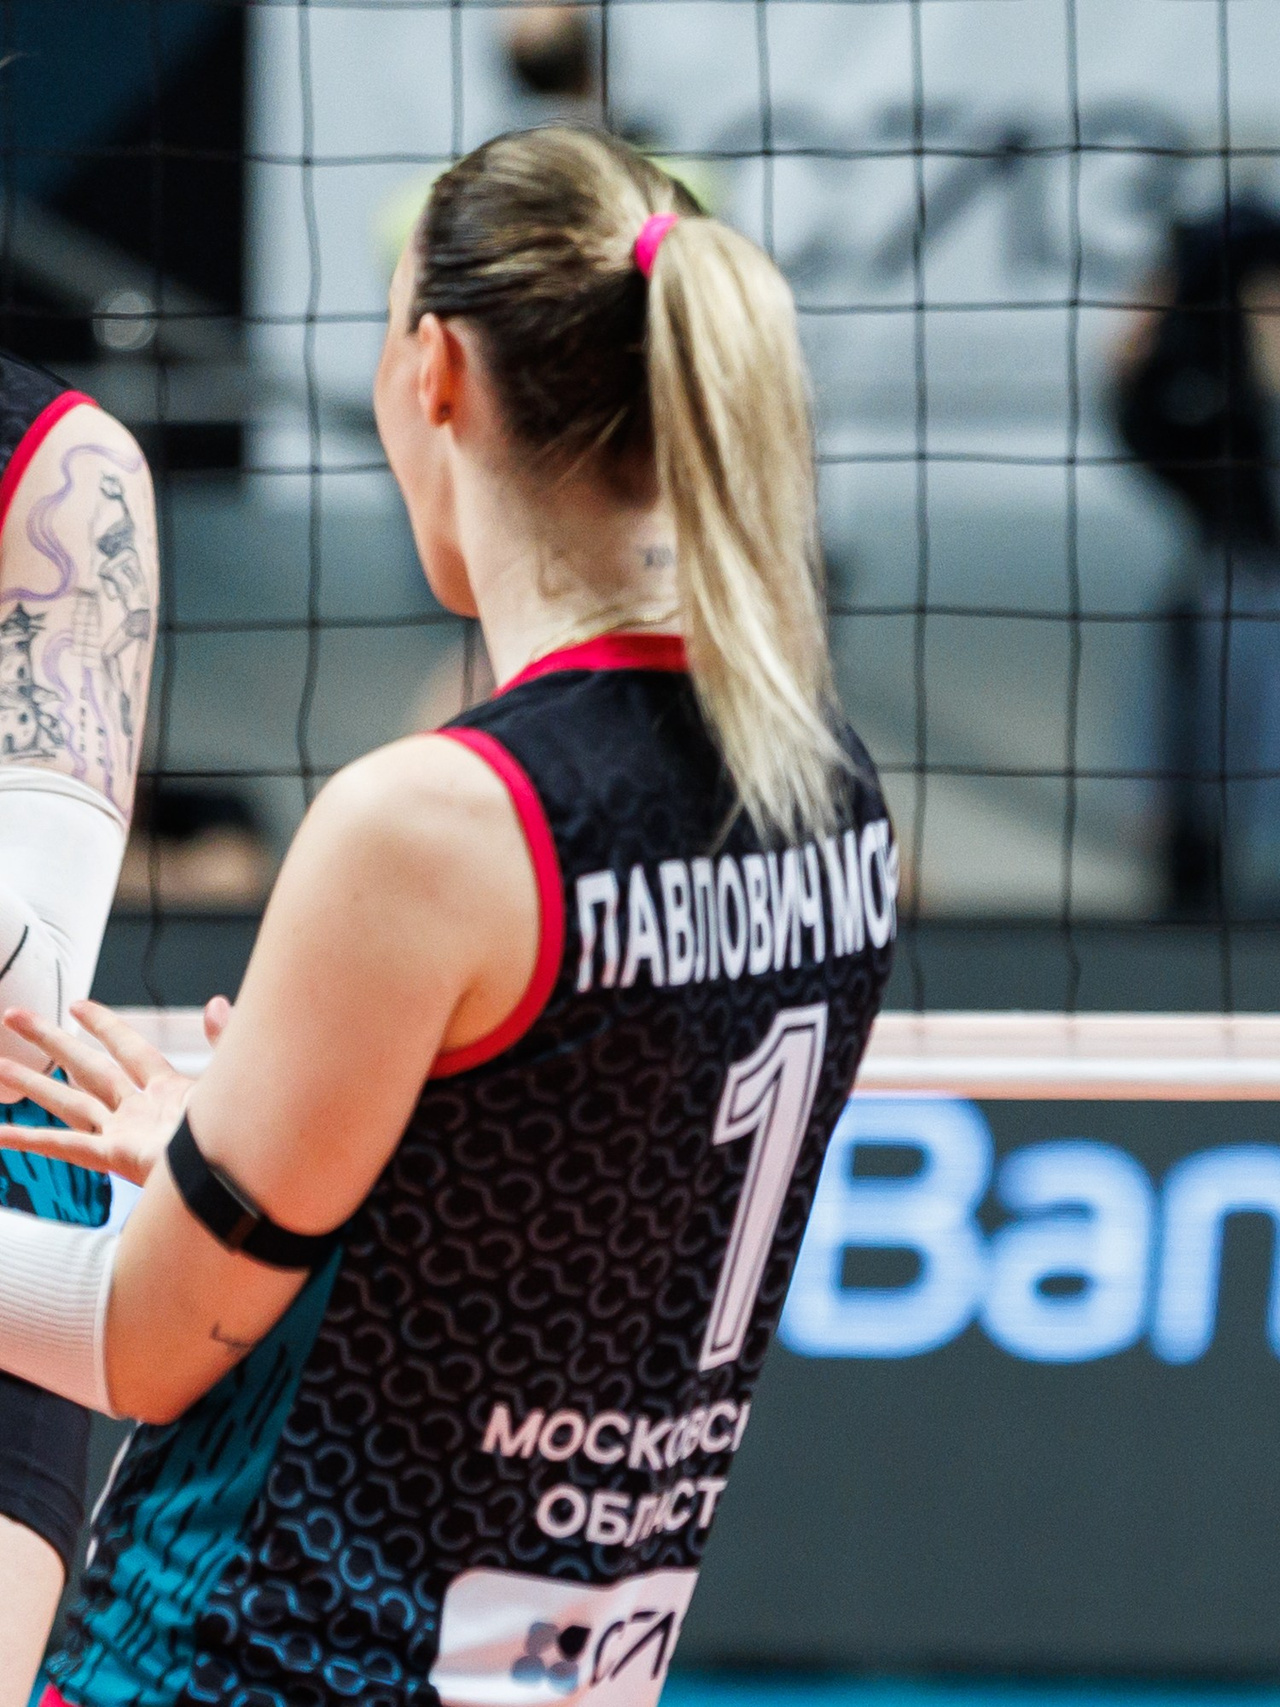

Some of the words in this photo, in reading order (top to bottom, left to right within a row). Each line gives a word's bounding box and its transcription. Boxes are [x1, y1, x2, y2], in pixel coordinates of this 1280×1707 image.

[575, 841, 827, 993] ПАВЛОВИЧ
[822, 818, 899, 958] МО
[698, 1002, 829, 1373] 1
[481, 1401, 752, 1471] МОСКОВС
